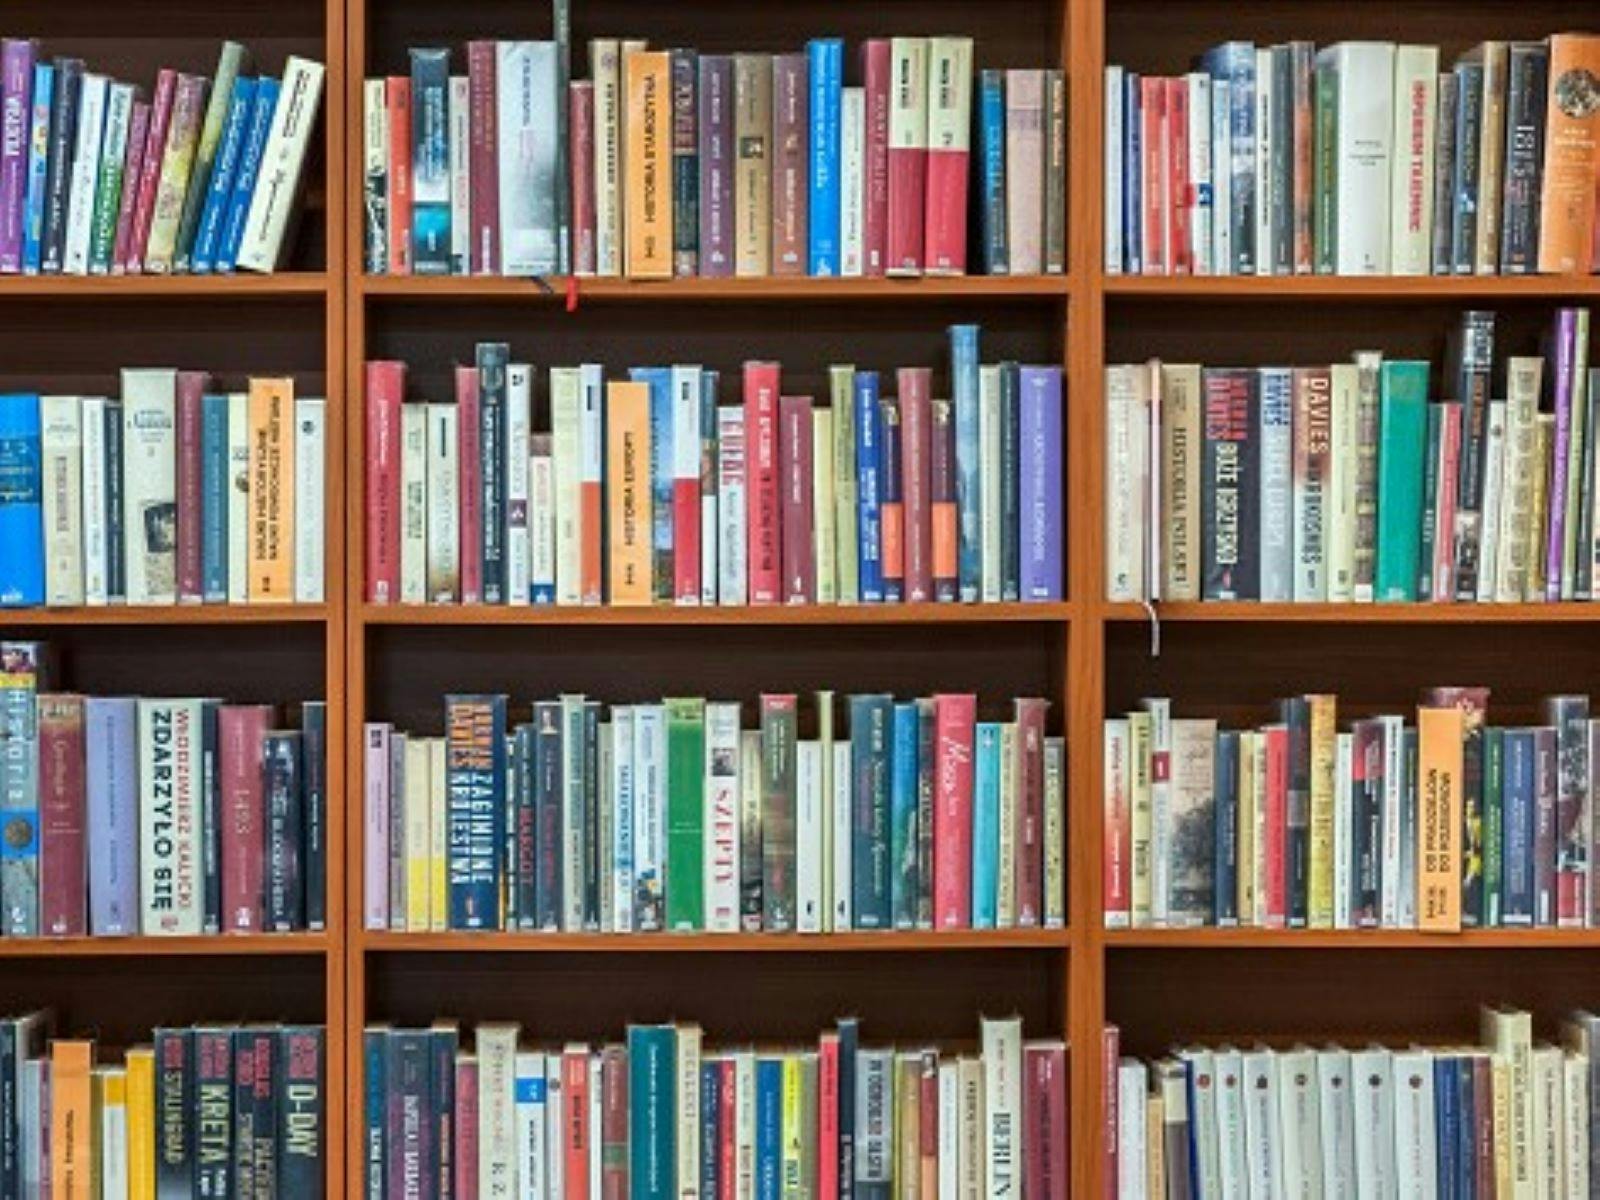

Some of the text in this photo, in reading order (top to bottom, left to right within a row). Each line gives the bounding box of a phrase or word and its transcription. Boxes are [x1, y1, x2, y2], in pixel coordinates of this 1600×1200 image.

[1309, 377, 1329, 455] DAVIES
[1172, 427, 1187, 513] HISTORIA
[624, 487, 635, 546] HISTORIA
[7, 690, 28, 801] Historia
[176, 708, 192, 835] WŁODZIMIERZ
[449, 704, 471, 768] DAVIES
[150, 709, 173, 911] ZDARZYŁO SIĘ
[472, 772, 493, 884] ZAGINIONE
[714, 788, 734, 888] SZEPTY
[164, 1071, 182, 1164] STALINGRAD
[201, 1084, 229, 1164] KRETA
[287, 1084, 318, 1157] D-DAY
[992, 1112, 1012, 1197] BERLIN
